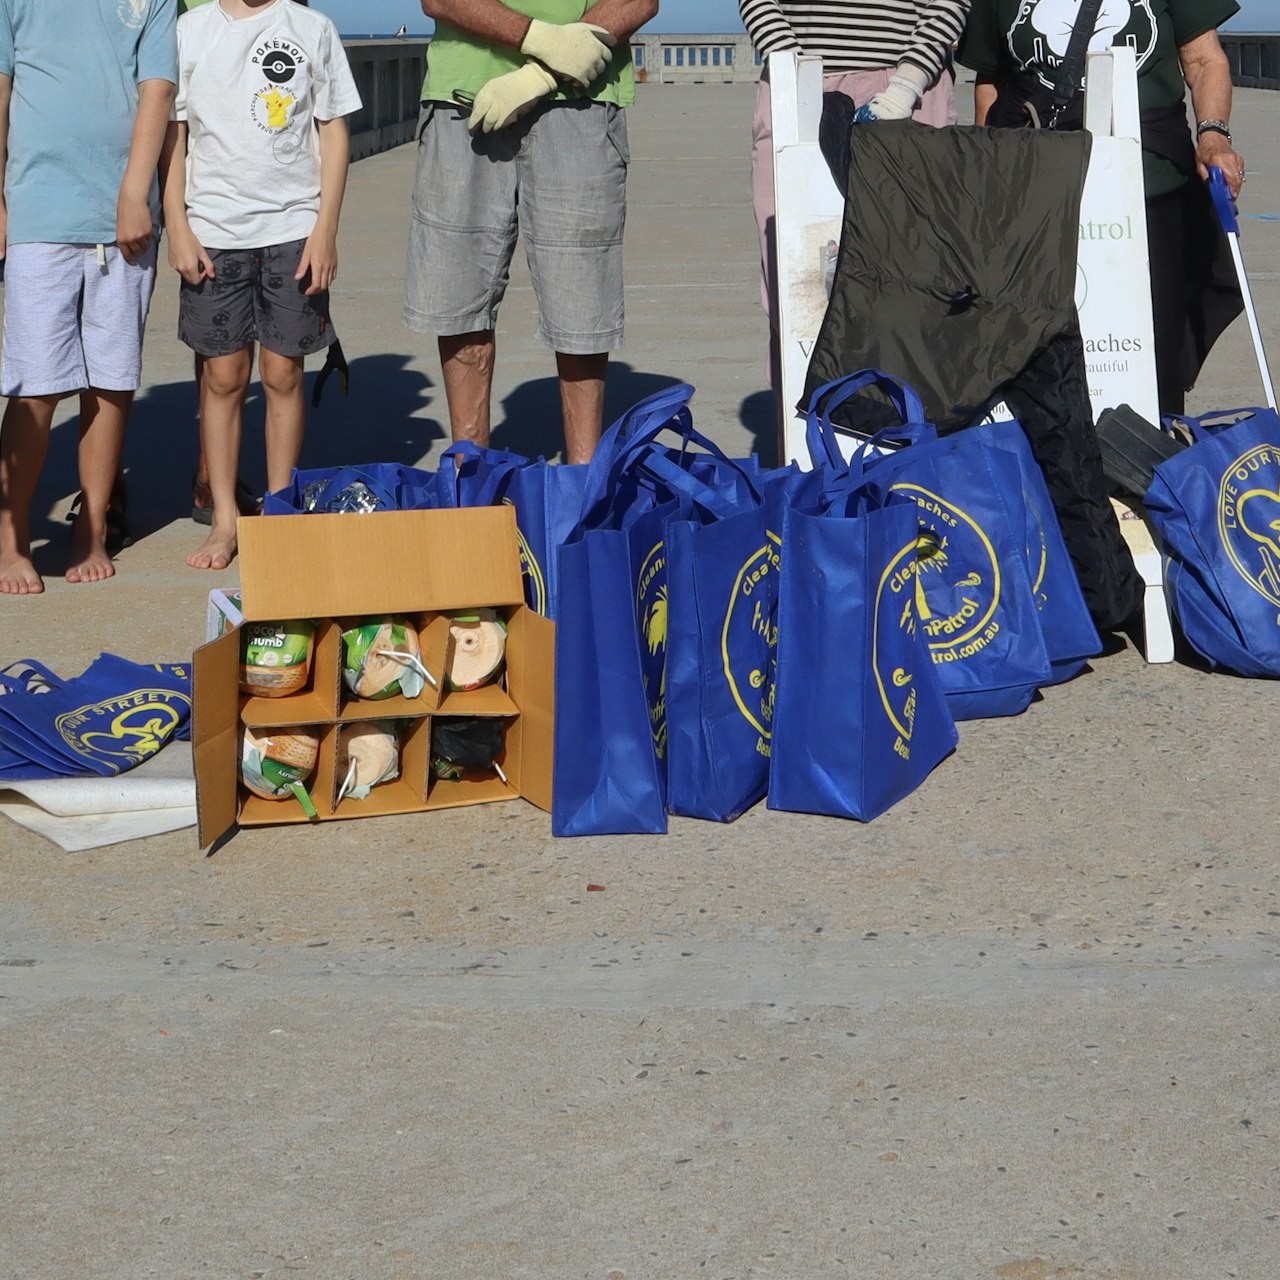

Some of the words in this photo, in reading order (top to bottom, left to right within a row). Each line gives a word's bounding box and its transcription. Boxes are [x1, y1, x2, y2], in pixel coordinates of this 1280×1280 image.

[1078, 216, 1134, 240] atrol
[1086, 333, 1142, 352] aches
[1225, 484, 1238, 529] LOVE
[1236, 452, 1271, 481] OUR
[92, 693, 174, 716] STREET
